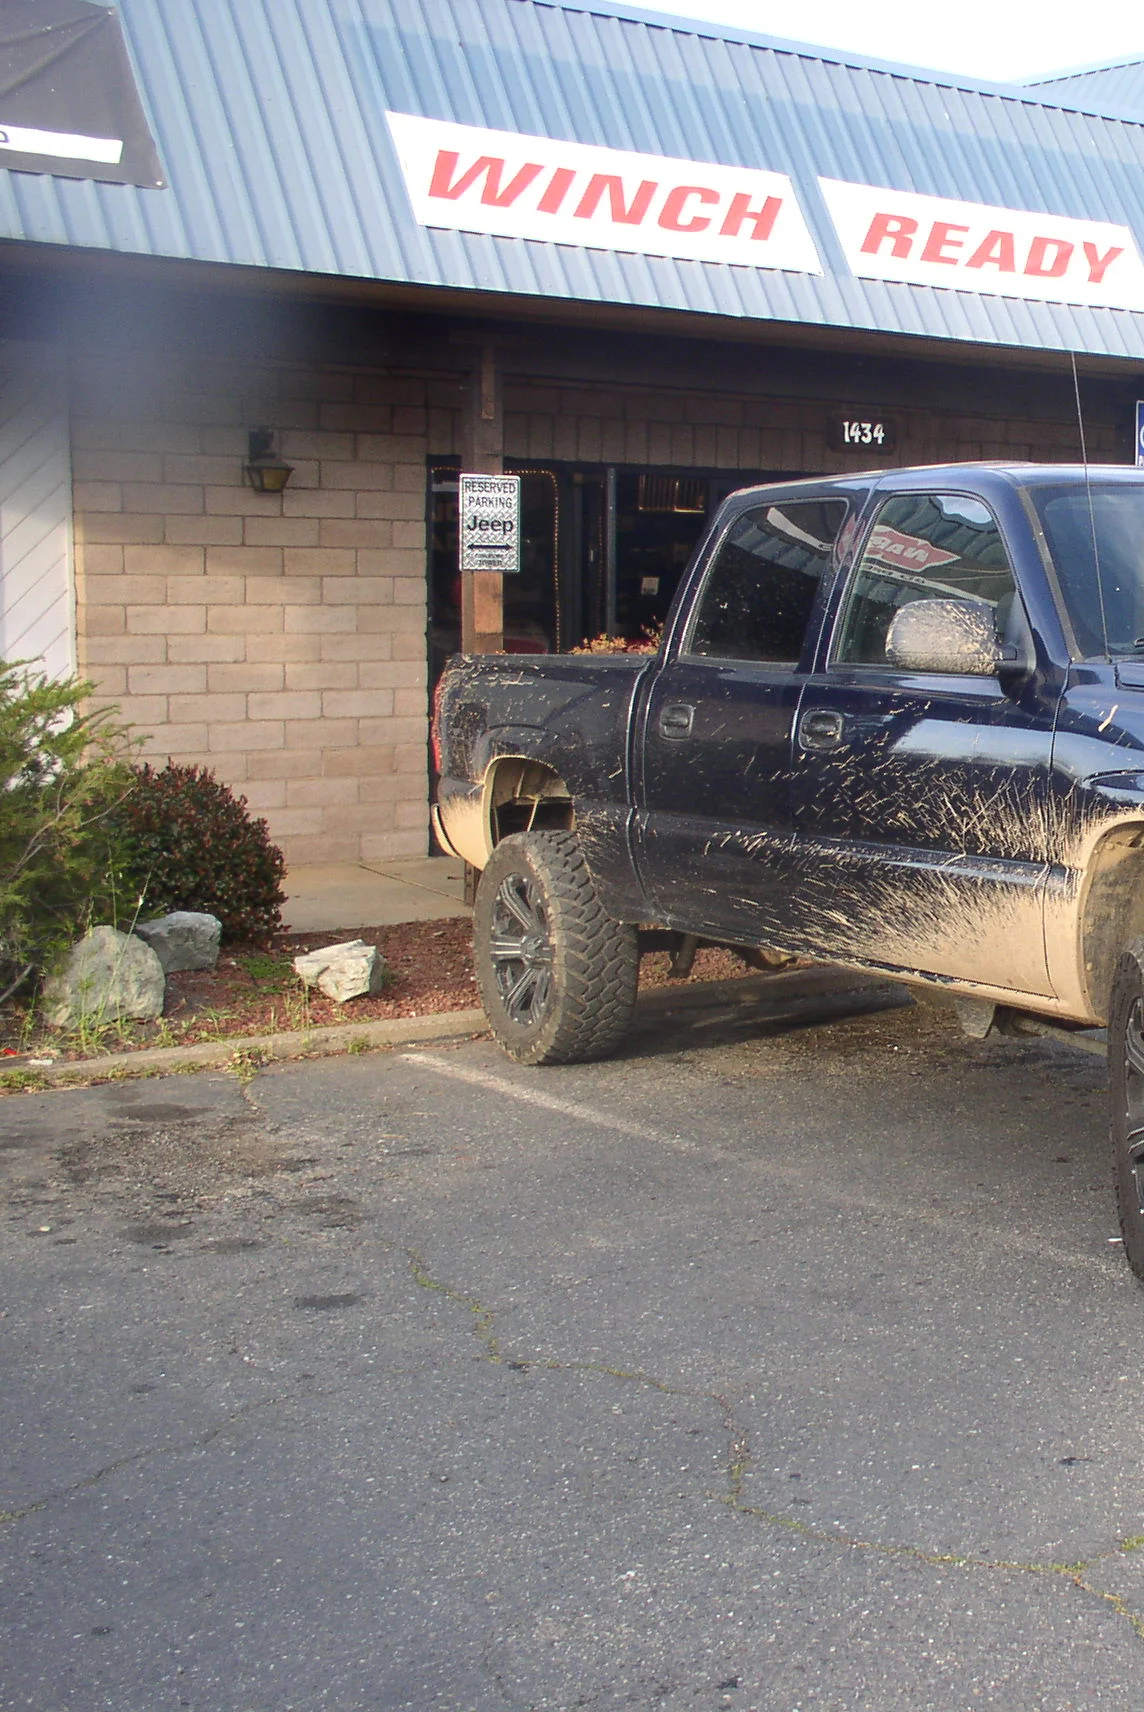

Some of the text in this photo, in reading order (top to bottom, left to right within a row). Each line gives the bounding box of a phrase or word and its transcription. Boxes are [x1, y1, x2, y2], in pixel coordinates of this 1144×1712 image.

[428, 149, 1124, 284] WINCH READY
[843, 421, 885, 444] 1434
[464, 481, 516, 493] RESERVED
[468, 496, 512, 508] PARKING
[467, 516, 513, 535] Jeep
